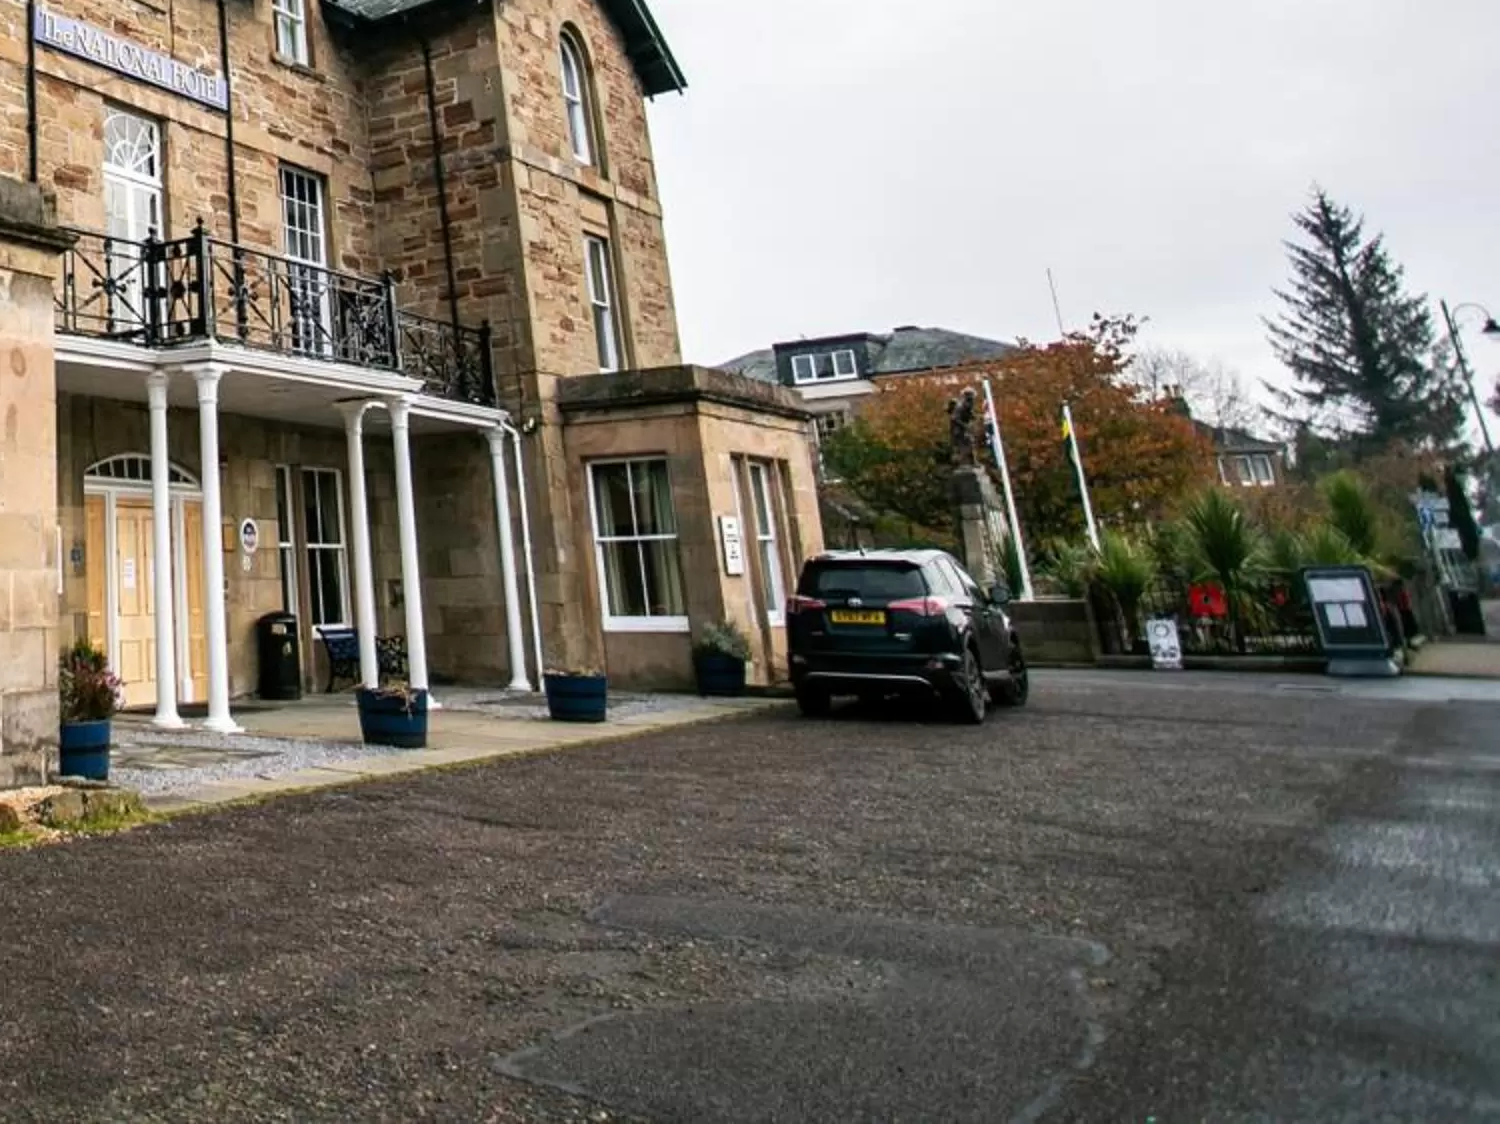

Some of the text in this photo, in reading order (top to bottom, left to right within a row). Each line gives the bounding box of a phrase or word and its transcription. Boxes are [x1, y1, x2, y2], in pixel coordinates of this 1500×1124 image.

[40, 10, 219, 102] The NATIONAL HOTEL
